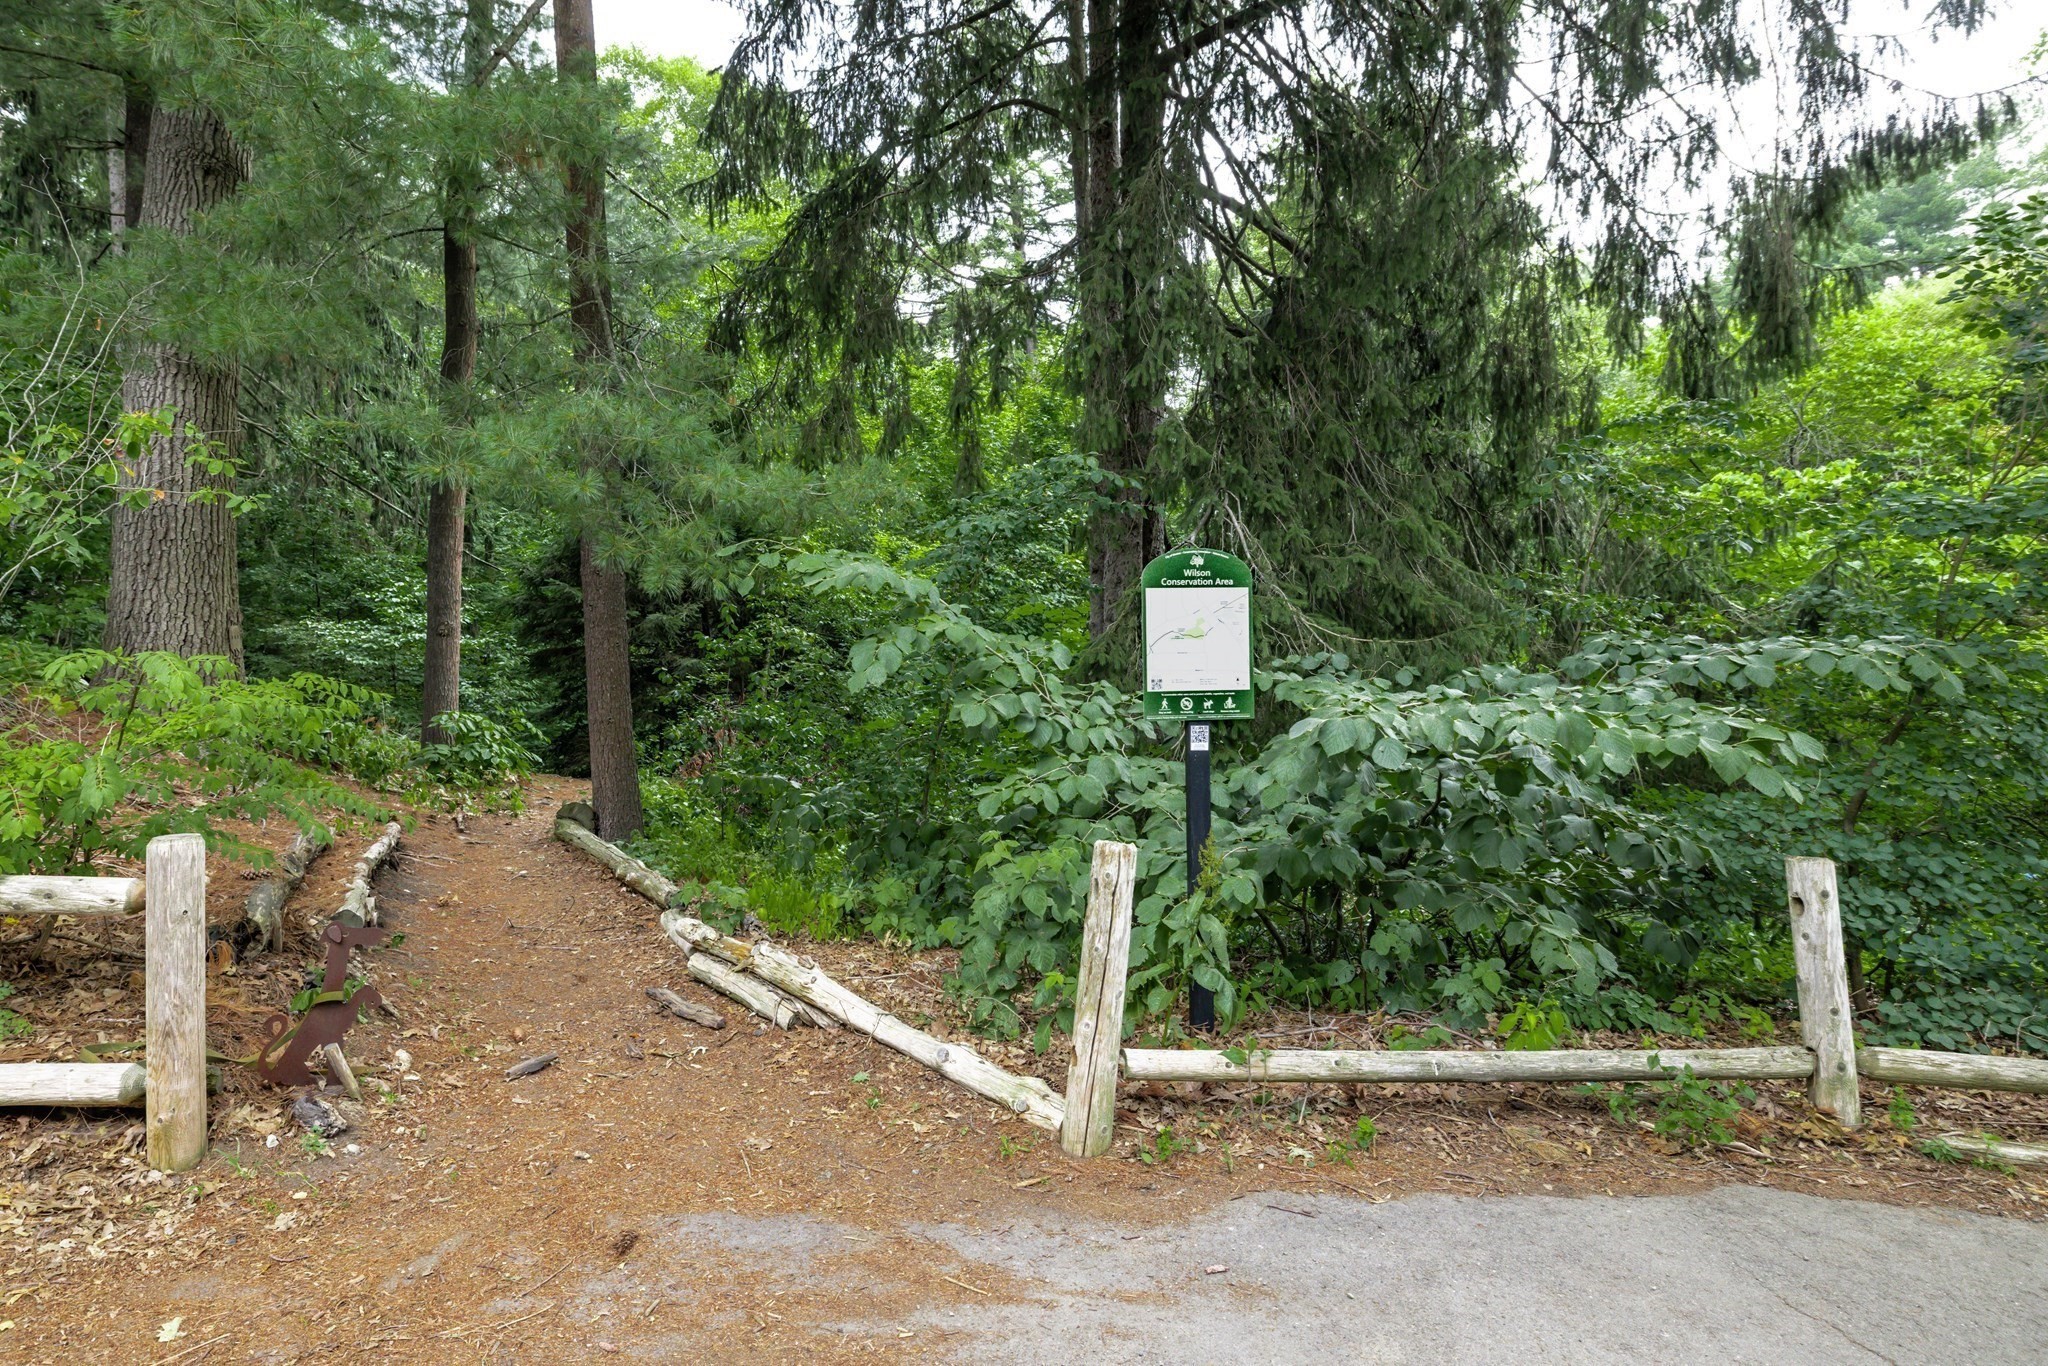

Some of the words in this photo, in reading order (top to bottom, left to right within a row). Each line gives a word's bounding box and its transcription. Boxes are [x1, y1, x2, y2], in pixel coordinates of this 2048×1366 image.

[1183, 568, 1211, 577] Wilson
[1161, 578, 1213, 586] Conservation
[1215, 578, 1233, 586] Area
